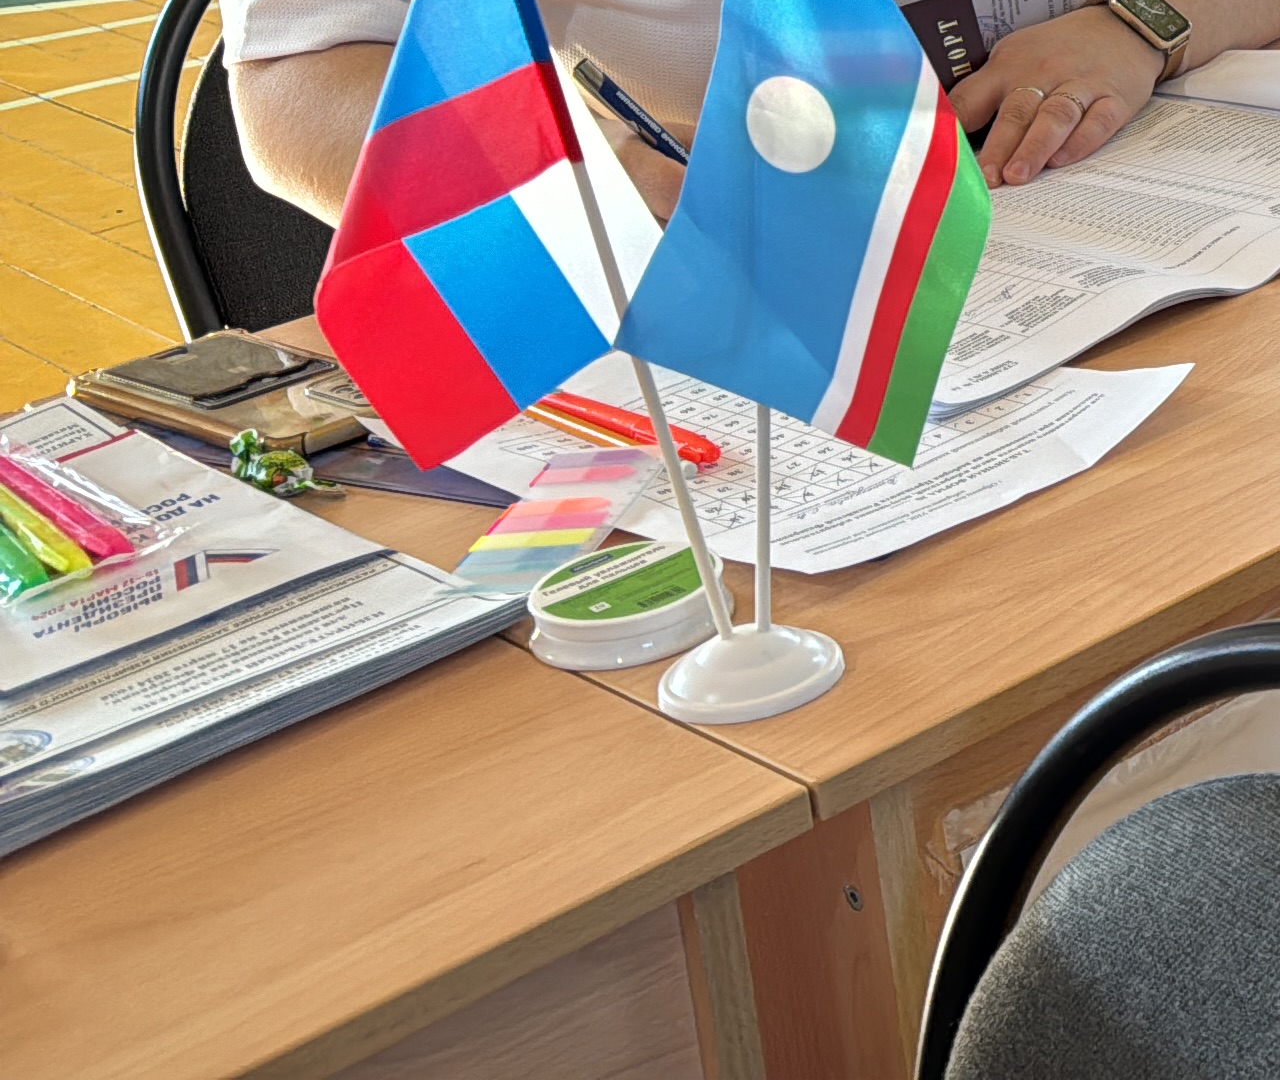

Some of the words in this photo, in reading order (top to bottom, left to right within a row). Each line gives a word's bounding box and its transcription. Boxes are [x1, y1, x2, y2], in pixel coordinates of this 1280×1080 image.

[541, 573, 593, 598] Гелевый
[592, 543, 667, 579] увлажнитель
[600, 557, 648, 581] пальцев
[31, 582, 161, 640] ПРЕЗИДЕНТА
[68, 583, 119, 608] МАРТА
[73, 591, 162, 634] ВЫБОРЫ
[81, 574, 160, 614] РОССИИ
[219, 642, 237, 654] 17
